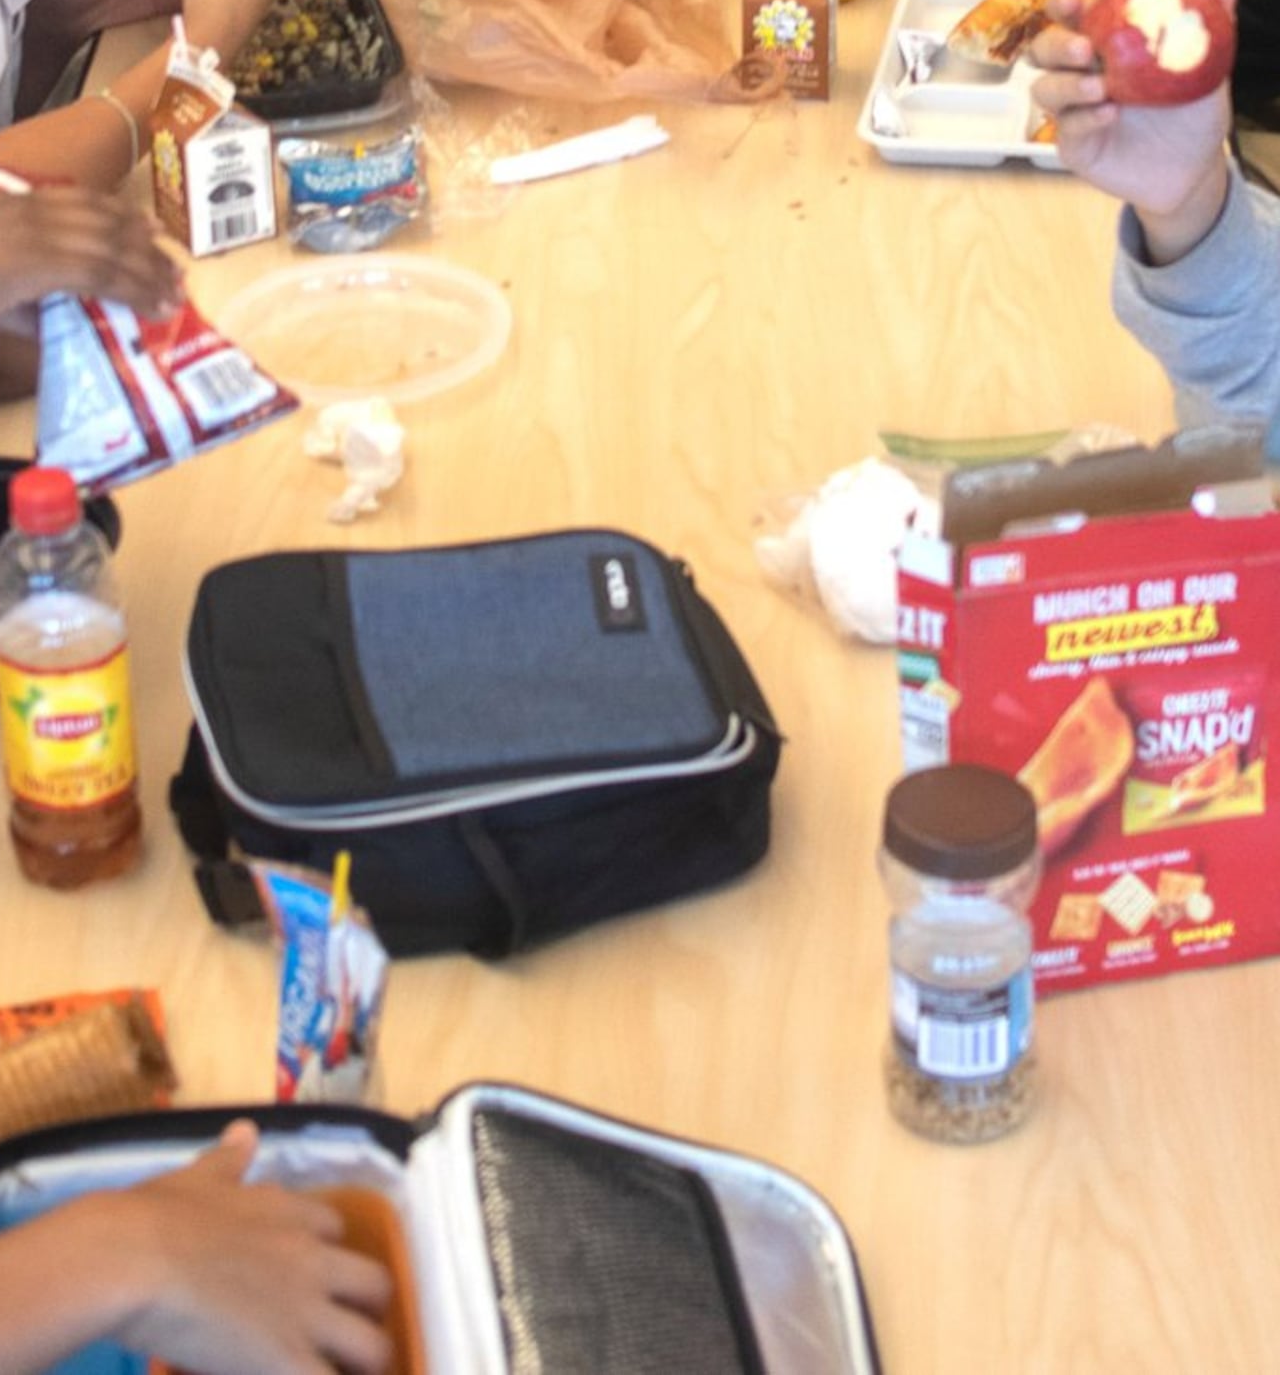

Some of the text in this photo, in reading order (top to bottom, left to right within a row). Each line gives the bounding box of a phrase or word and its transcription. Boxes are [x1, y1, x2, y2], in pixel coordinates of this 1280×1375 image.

[1033, 571, 1237, 625] MUNCH ON OUR
